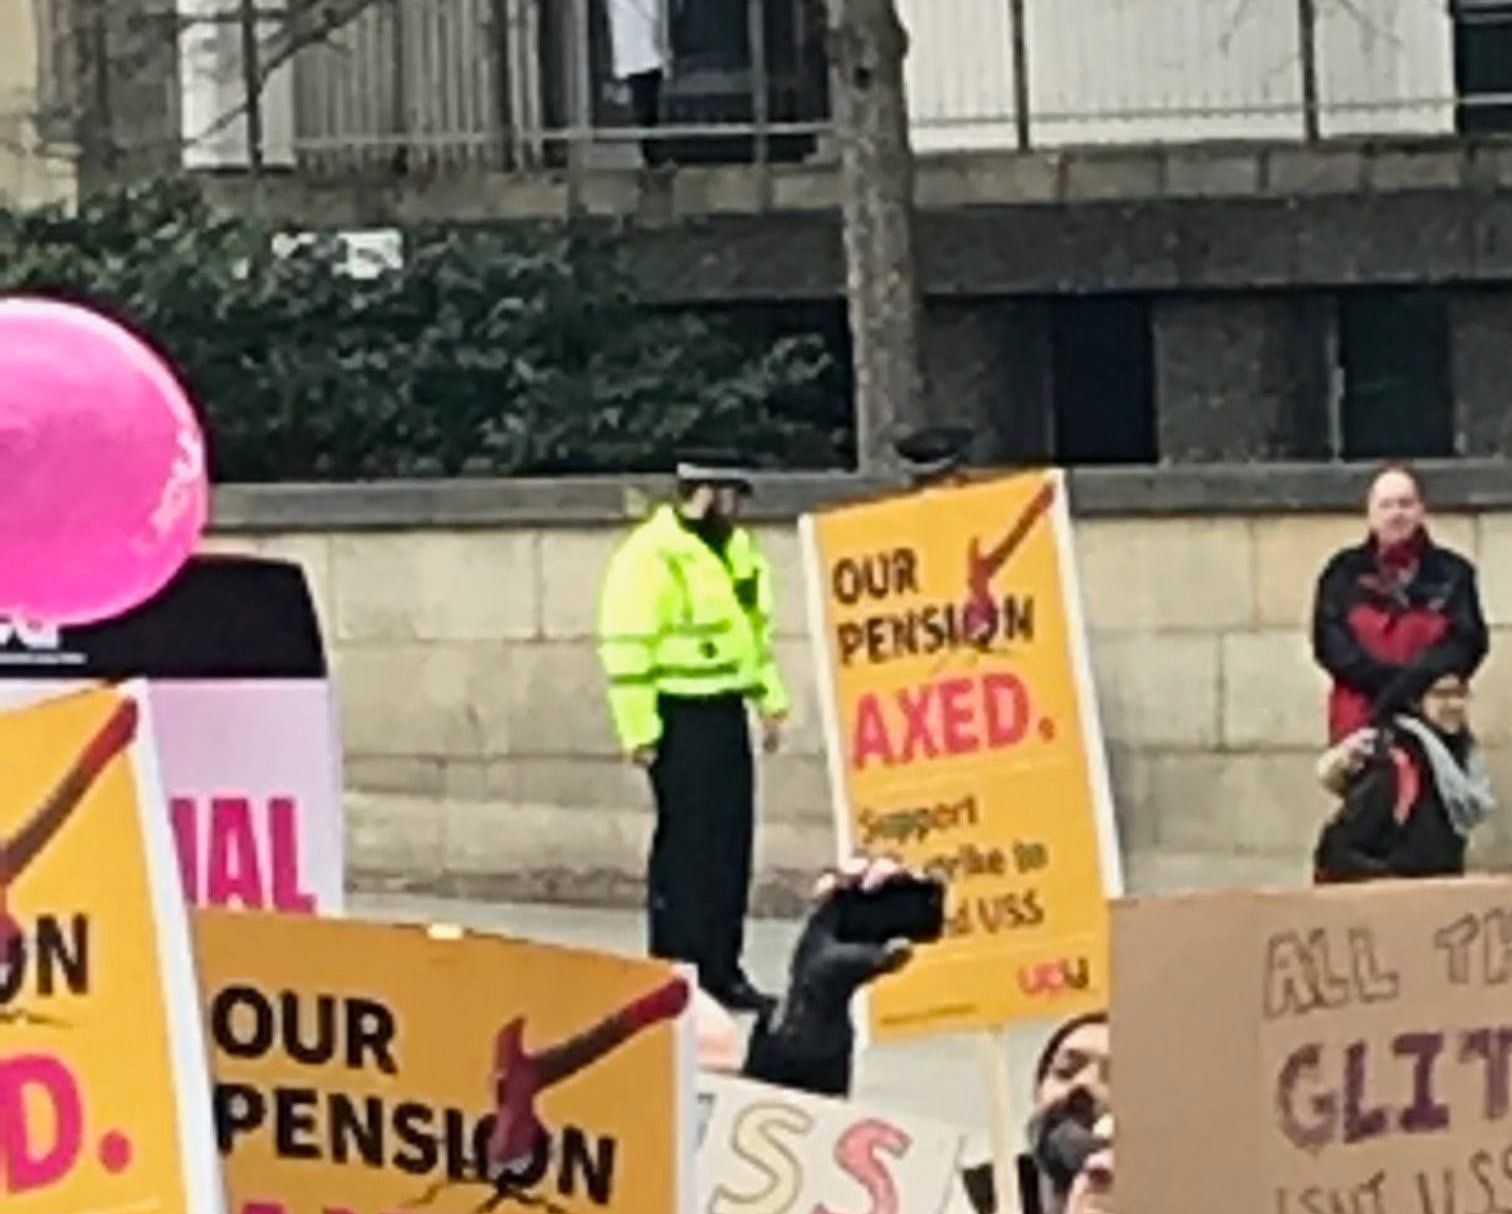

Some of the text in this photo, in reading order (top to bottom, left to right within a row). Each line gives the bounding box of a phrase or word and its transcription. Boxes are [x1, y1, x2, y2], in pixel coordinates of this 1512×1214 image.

[834, 547, 919, 605] OUR
[838, 594, 1035, 666] PENSION
[852, 672, 1056, 770] AXED.
[1262, 926, 1400, 1020] ALL
[211, 985, 398, 1075] OUR
[213, 1082, 618, 1206] PENSION
